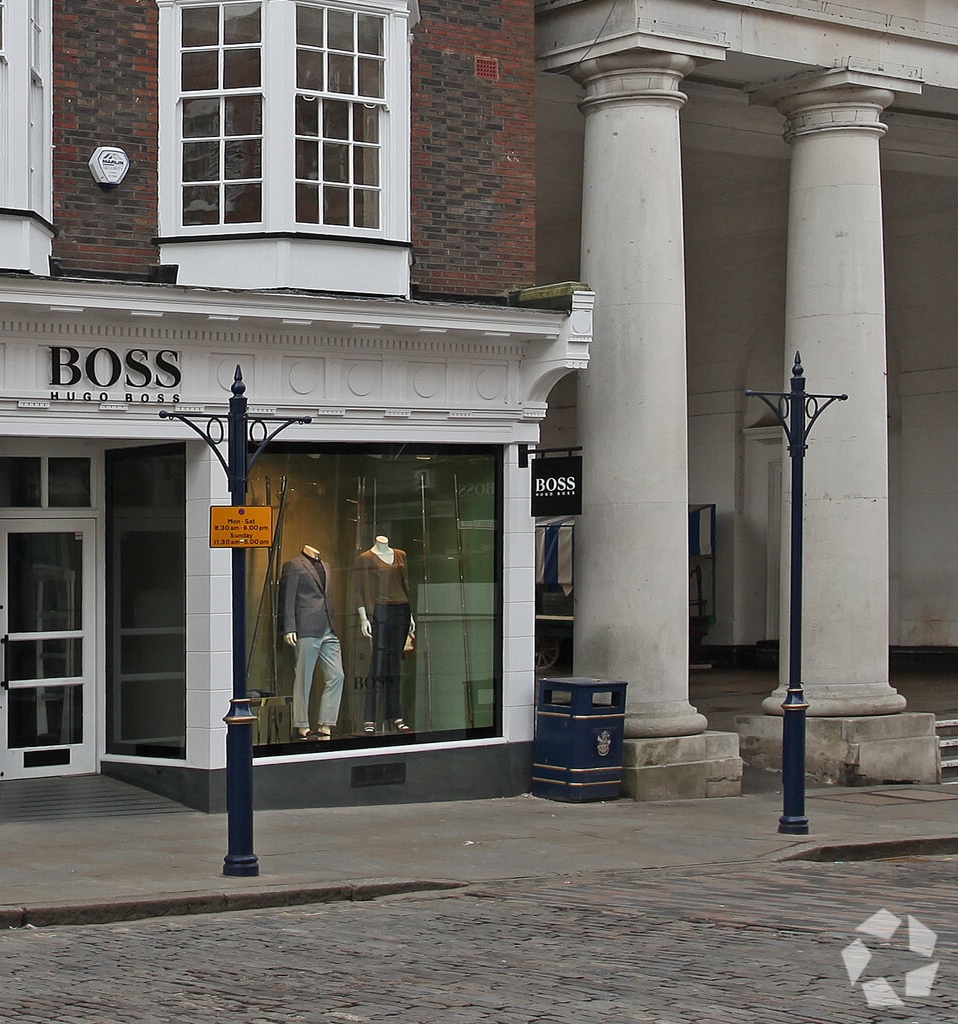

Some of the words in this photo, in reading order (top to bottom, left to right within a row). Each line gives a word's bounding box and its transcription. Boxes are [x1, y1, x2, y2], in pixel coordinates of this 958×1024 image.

[49, 346, 181, 388] BOSS
[51, 391, 108, 402] HUGO
[125, 393, 180, 404] BOSS
[535, 476, 576, 491] BOSS
